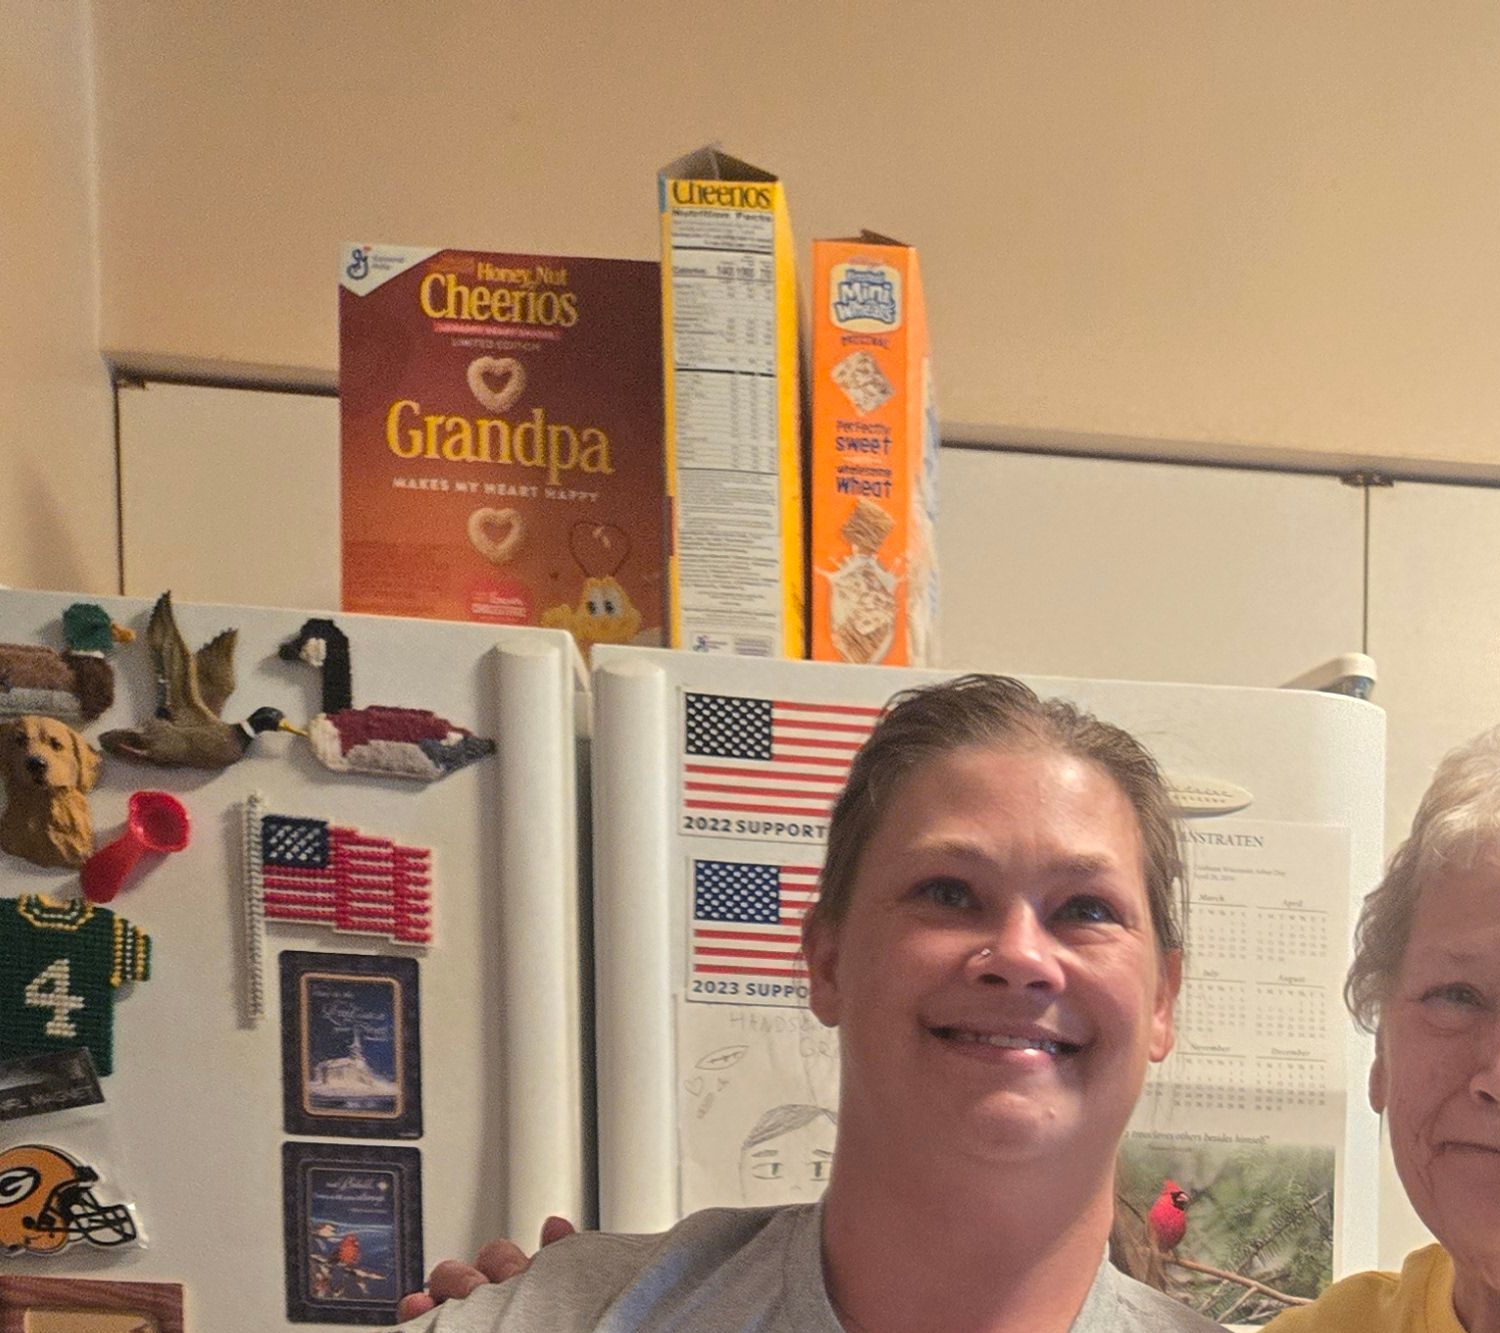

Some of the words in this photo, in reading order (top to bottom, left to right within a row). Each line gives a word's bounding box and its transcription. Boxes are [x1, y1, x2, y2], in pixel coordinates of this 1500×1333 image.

[420, 272, 580, 328] Cheerios
[385, 399, 616, 487] Grandpa
[392, 476, 449, 491] MAKES
[455, 478, 480, 493] MY
[484, 480, 538, 498] HEART
[683, 816, 731, 832] 2022
[24, 958, 85, 1037] 4
[692, 979, 739, 995] 2023
[746, 982, 809, 998] SUPPO
